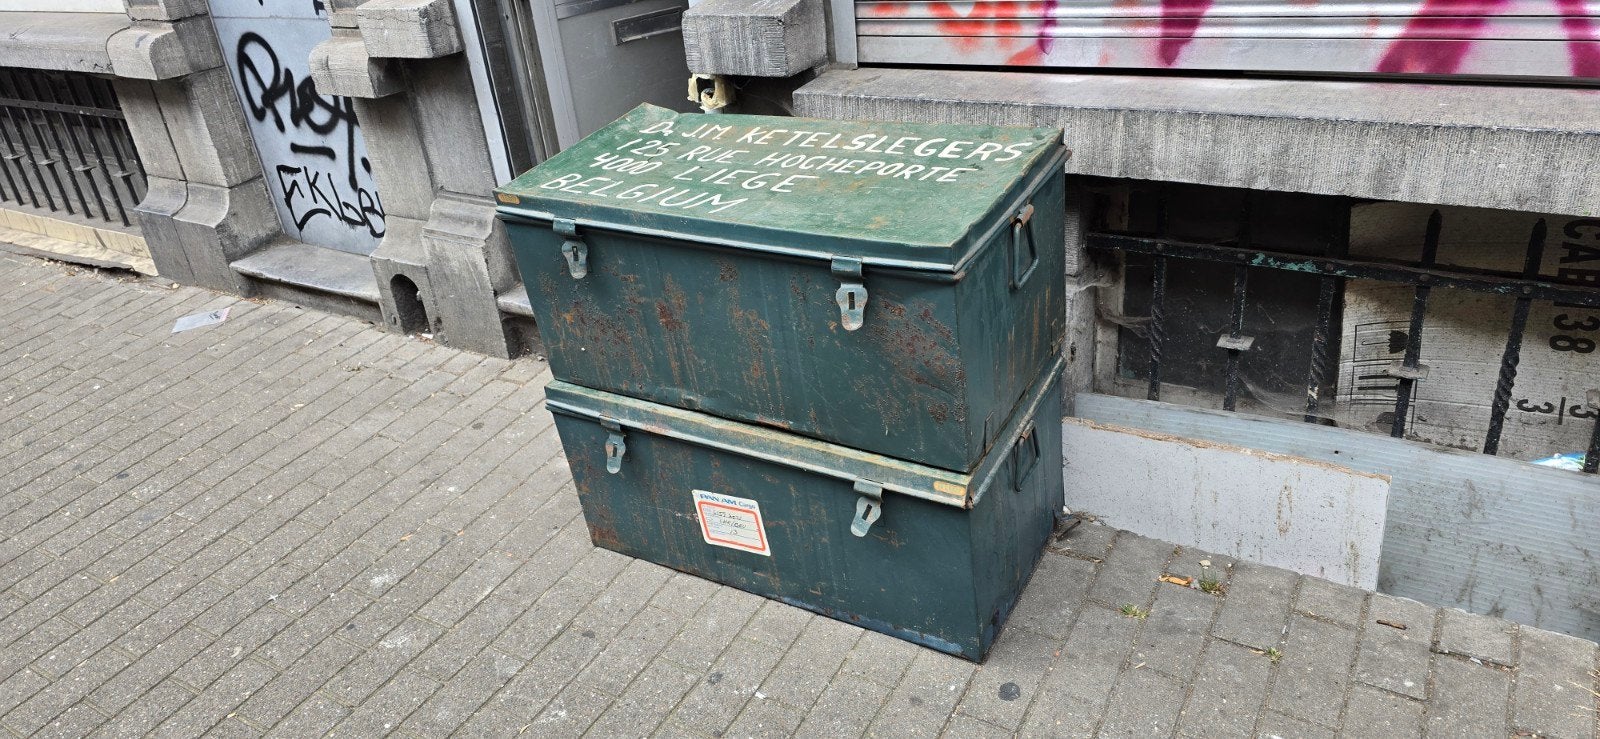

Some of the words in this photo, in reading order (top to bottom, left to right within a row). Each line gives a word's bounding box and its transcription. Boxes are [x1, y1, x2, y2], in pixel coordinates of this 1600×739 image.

[617, 138, 681, 157] 125
[676, 145, 750, 163] RUE
[753, 151, 979, 182] HOCHEPORTE
[736, 126, 1033, 162] KETELSLEGERS
[589, 152, 663, 175] 4000
[672, 165, 820, 193] LIEGE
[540, 173, 749, 214] BELGIUM
[700, 493, 720, 503] PAN
[721, 498, 737, 506] AM
